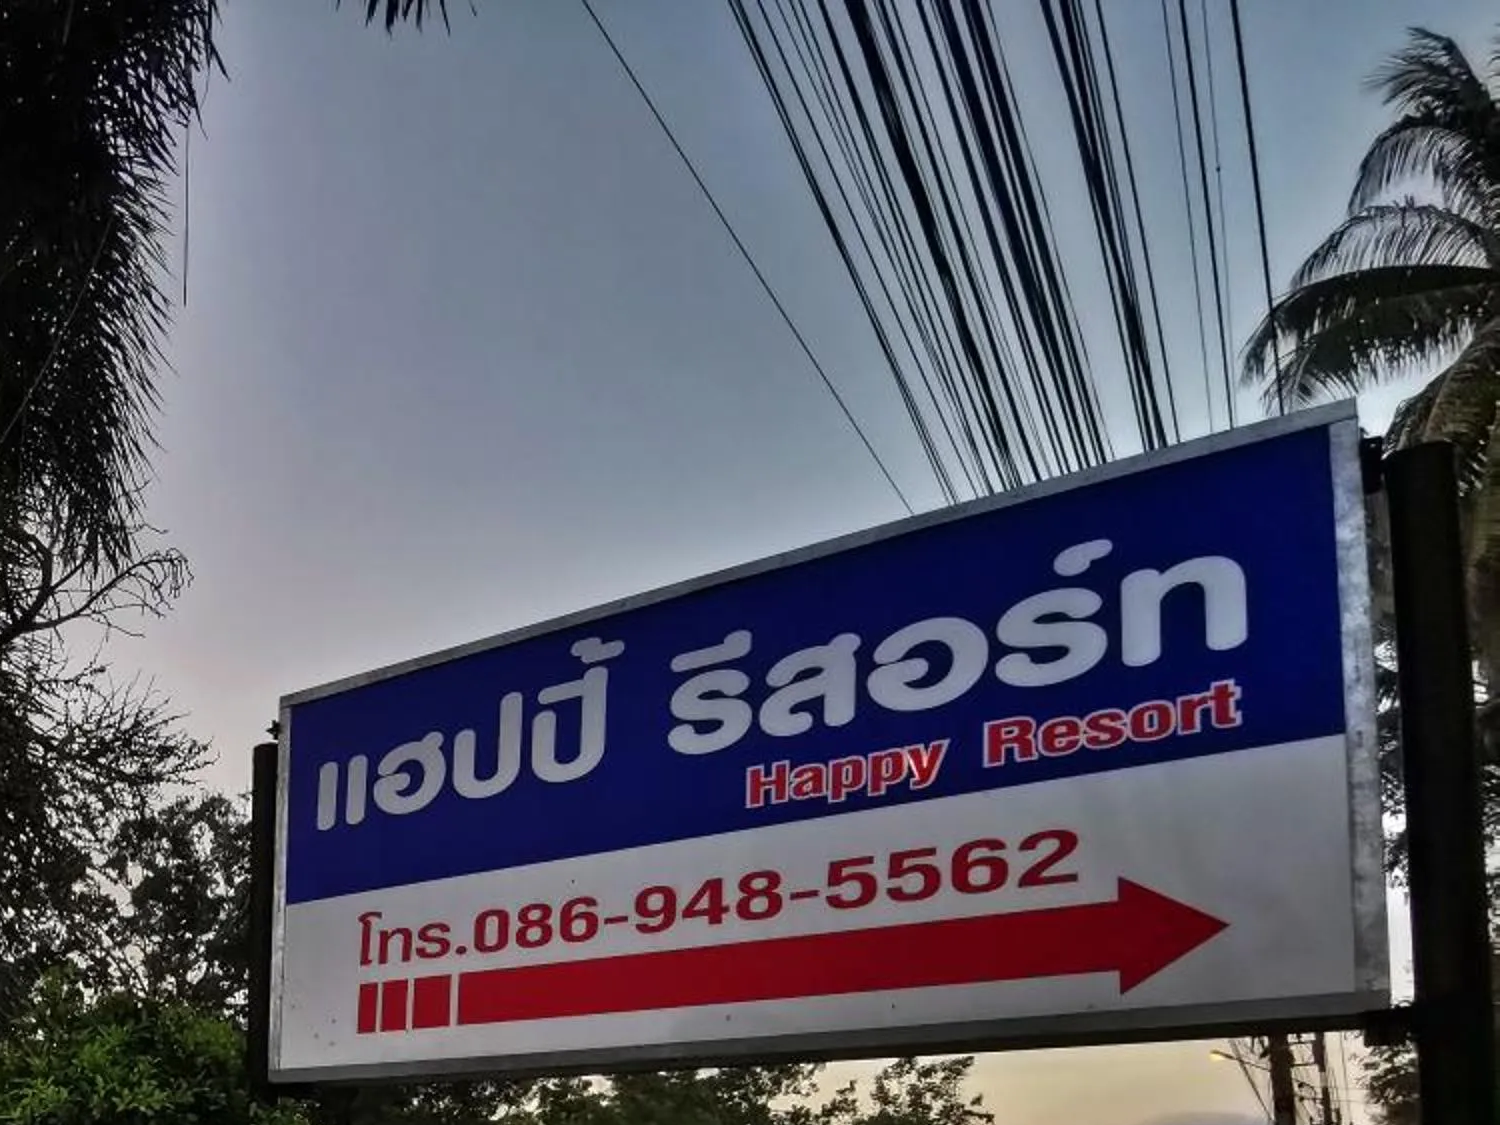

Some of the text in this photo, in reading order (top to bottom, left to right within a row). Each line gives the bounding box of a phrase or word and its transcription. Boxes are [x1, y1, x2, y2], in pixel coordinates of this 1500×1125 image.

[316, 539, 1249, 831] แฮปปี้ รีสอร์ท
[745, 679, 1243, 808] Happy Resort
[357, 828, 1080, 967] โทร.086-948-5562
